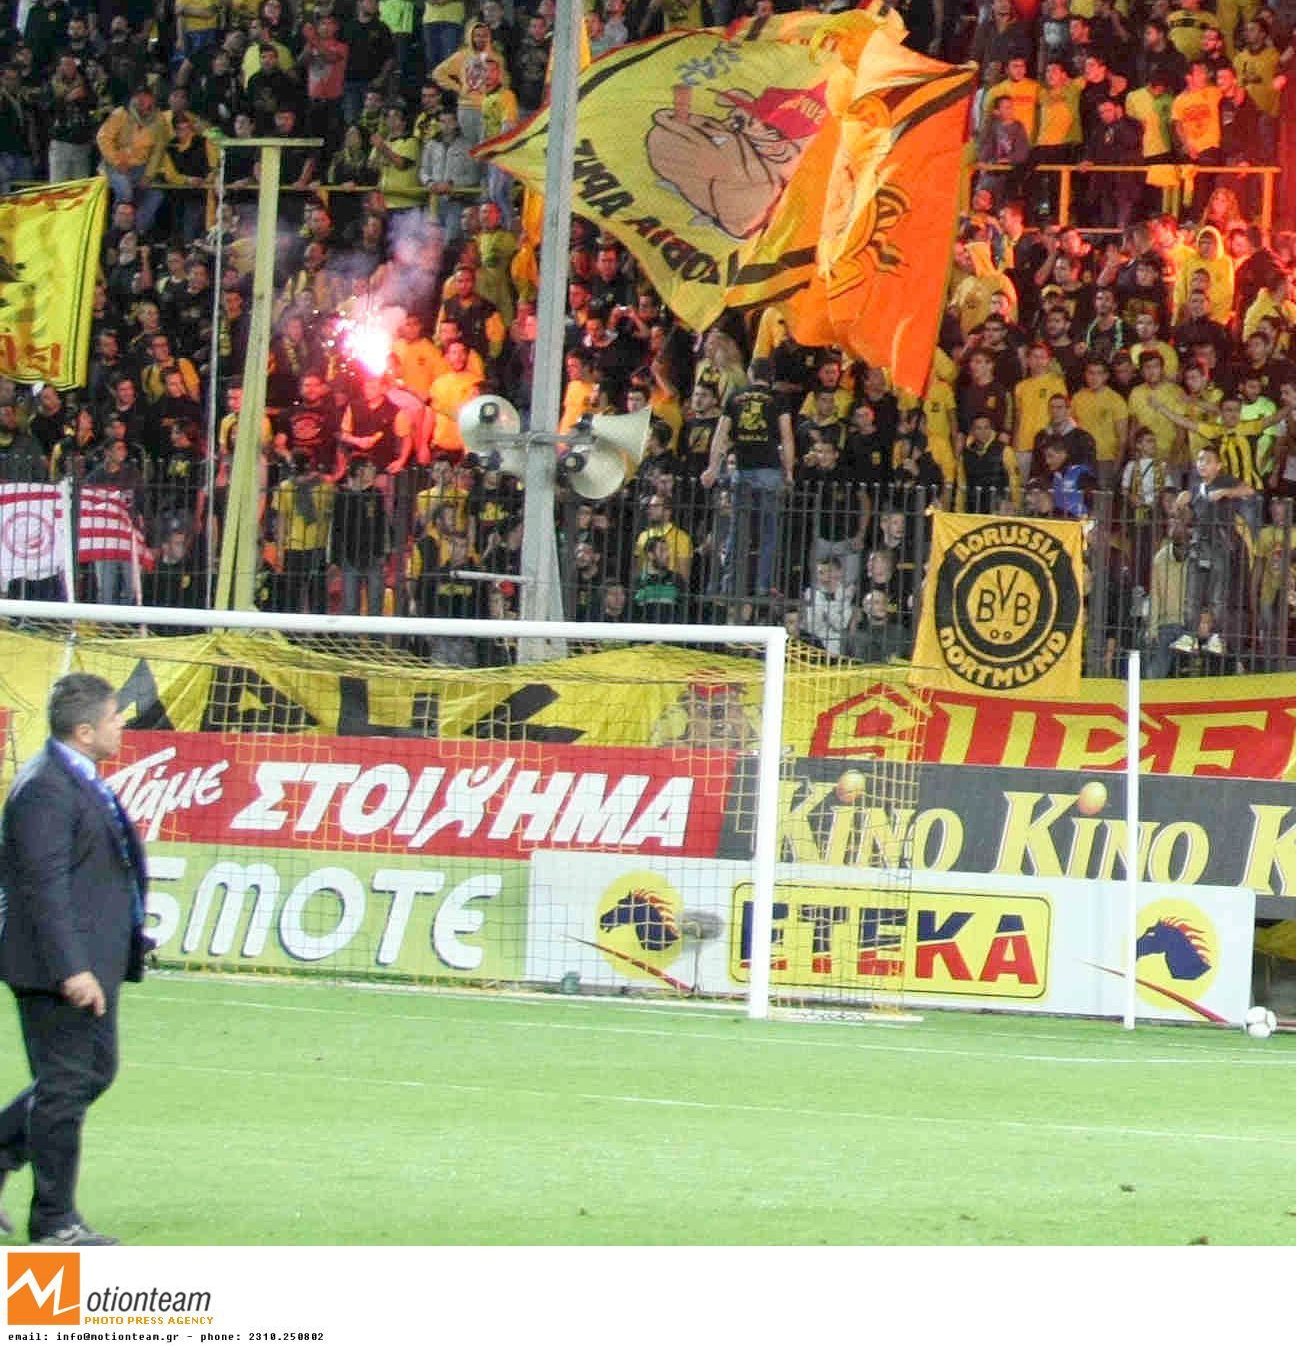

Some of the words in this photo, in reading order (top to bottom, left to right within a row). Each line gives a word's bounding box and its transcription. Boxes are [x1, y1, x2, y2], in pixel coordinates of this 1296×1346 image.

[976, 570, 1031, 626] BVB
[940, 626, 1067, 688] DORTMUND
[991, 790, 1210, 886] KINO
